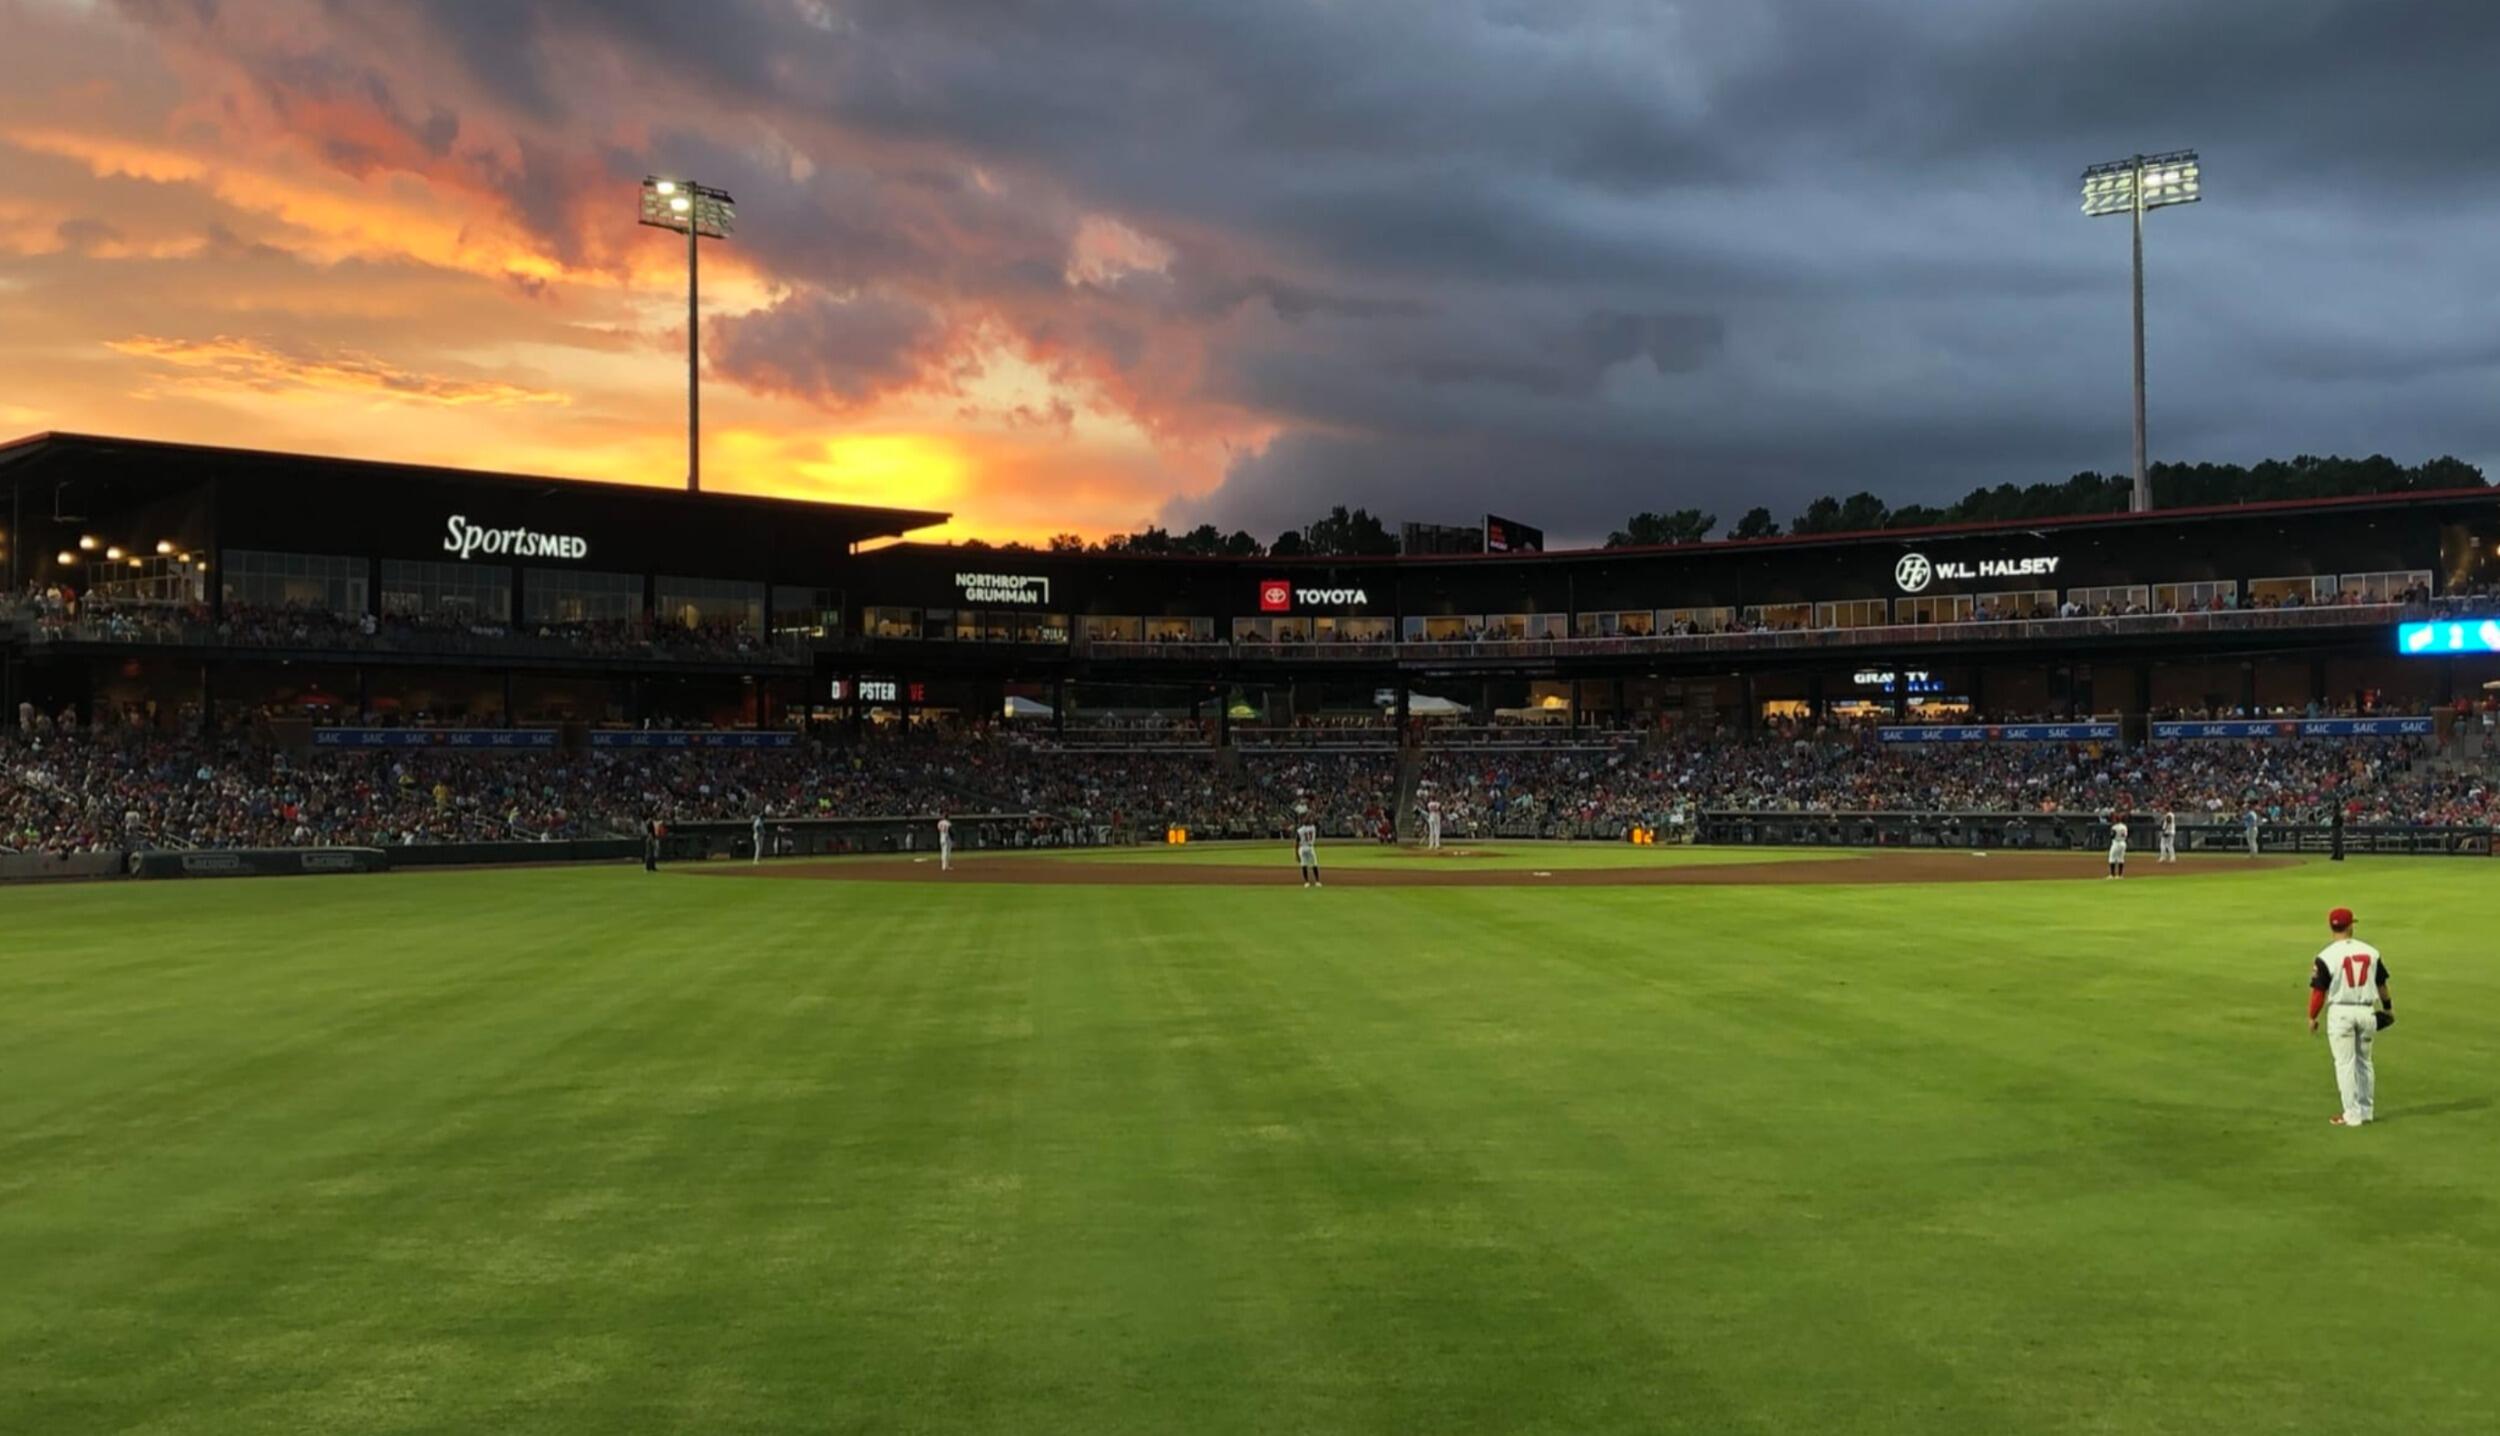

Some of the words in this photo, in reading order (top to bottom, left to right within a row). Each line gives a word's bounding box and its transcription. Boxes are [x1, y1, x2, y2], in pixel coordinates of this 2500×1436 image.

[443, 514, 588, 559] SportsMED
[1935, 562, 1976, 579] W.L.
[1979, 557, 2059, 577] HALSEY
[955, 573, 1028, 589] NORTHROP
[965, 587, 1038, 604] GRUMMAN
[1296, 589, 1368, 605] TOYOTA
[1882, 731, 1904, 740] SAIC
[1921, 730, 1943, 740] SAIC
[1961, 730, 1983, 739] SAIC
[2007, 729, 2029, 738] SAIC
[2048, 728, 2070, 738] SAIC
[2090, 727, 2112, 737] SAIC
[2158, 726, 2182, 737] SAIC
[2202, 725, 2225, 736] SAIC
[2247, 724, 2271, 735] SAIC
[2305, 723, 2330, 734] SAIC
[2352, 722, 2378, 733] SAIC
[2400, 721, 2426, 733] SAIC
[317, 732, 341, 743] SAIC
[361, 733, 385, 744] SAIC
[405, 733, 427, 744] SAIC
[450, 733, 472, 744] SAIC
[491, 733, 513, 744] SAIC
[531, 734, 553, 745] SAIC
[2342, 954, 2371, 987] 17
